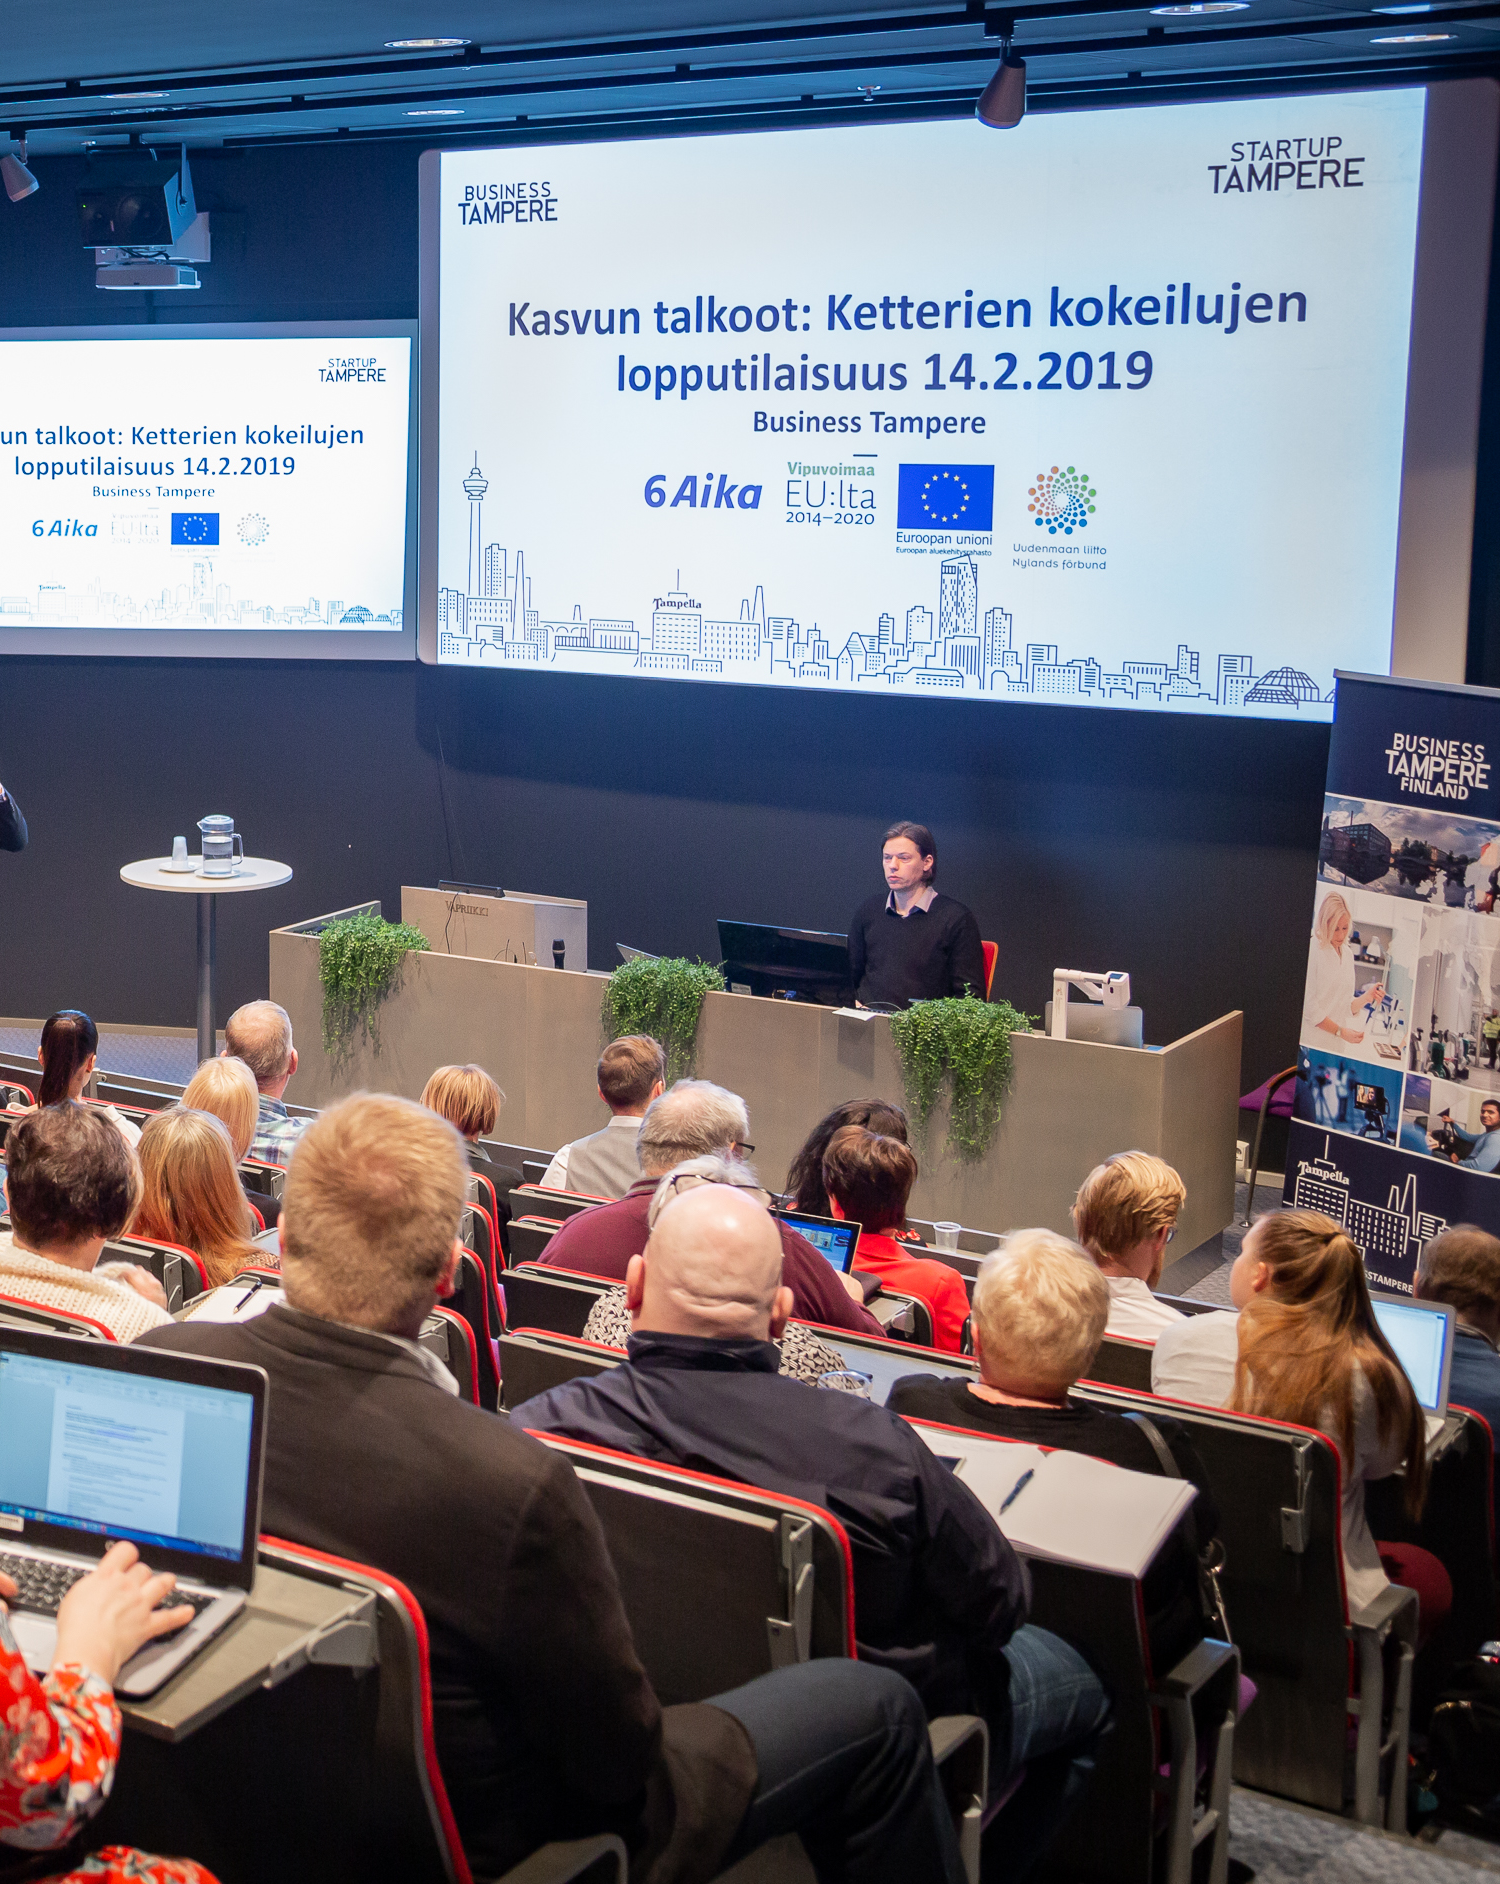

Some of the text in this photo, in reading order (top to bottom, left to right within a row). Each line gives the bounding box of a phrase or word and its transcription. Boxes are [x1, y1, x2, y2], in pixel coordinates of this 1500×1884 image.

[1230, 136, 1342, 162] STARTUP
[1207, 157, 1365, 194] TAMPERE
[465, 181, 551, 201] BUSINESS
[458, 198, 558, 225] TAMPERE
[509, 281, 1307, 336] Kasvun talkoot: Ketterien kokeilujen
[318, 368, 387, 382] TAMPERE
[328, 358, 377, 368] STARTUP
[617, 350, 1154, 401] lopputilaisuus 14.2.2019
[34, 425, 123, 446] talkoot:
[132, 425, 237, 445] Ketterien
[245, 424, 364, 449] kokeilujen
[753, 410, 986, 440] Business Tampere
[15, 455, 295, 481] lopputilaisuus 14.2.2019
[787, 461, 875, 477] Vipuvoimaa
[92, 485, 215, 500] Business Tampere
[786, 479, 877, 510] EU:lta
[895, 546, 928, 555] Euroopan
[896, 531, 993, 547] Euroopan unioni
[1013, 543, 1107, 555] Uudenmaan liitto
[1012, 558, 1107, 570] Nylands förbund
[652, 597, 702, 611] Tampella
[1393, 732, 1485, 763] BUSINESS
[1385, 749, 1491, 790] TAMPERE
[1400, 776, 1469, 800] FINLAND
[1297, 1160, 1350, 1186] Tampella
